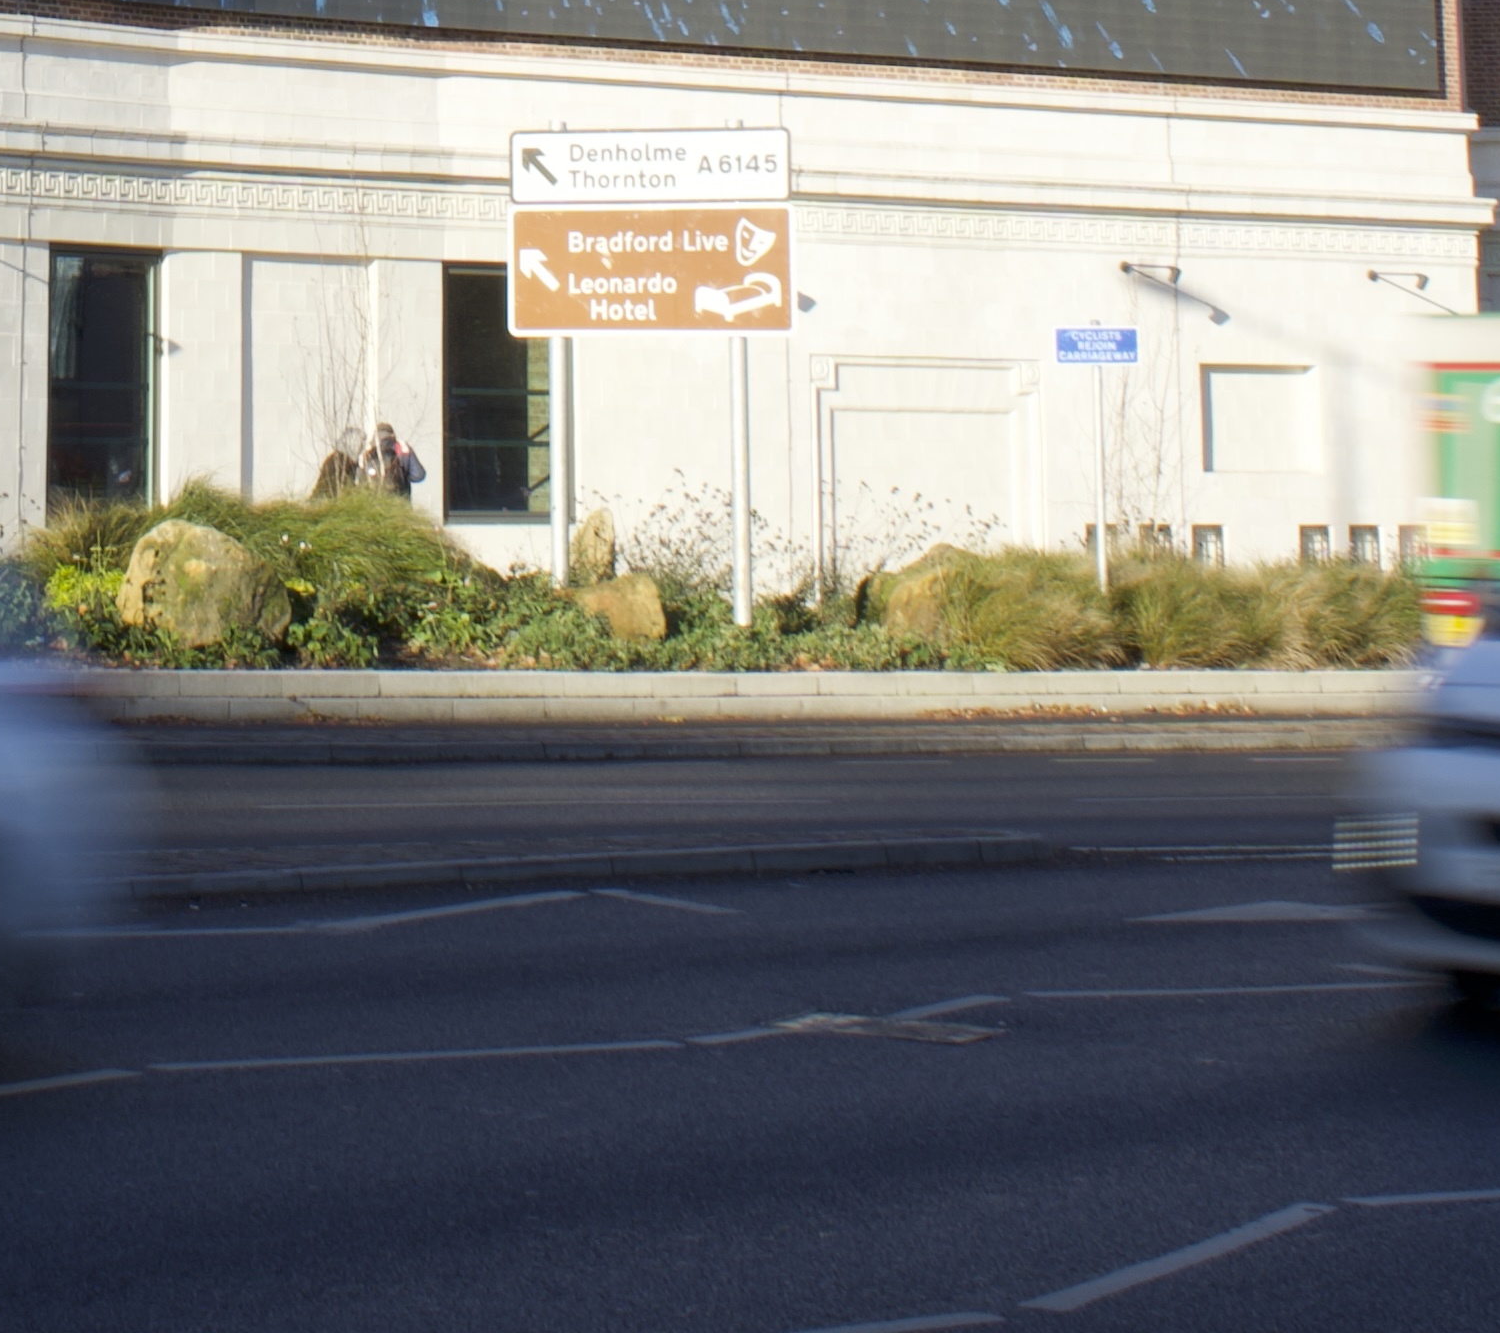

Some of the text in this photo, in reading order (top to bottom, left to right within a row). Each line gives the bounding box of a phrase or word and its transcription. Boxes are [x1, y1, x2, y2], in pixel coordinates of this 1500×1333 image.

[569, 143, 687, 162] Denholme
[568, 169, 677, 189] Thornton
[567, 230, 729, 253] Bradford Live
[567, 272, 678, 295] Leonardo
[589, 298, 657, 321] Hotel
[1070, 331, 1122, 341] CYCLISTS
[1077, 341, 1117, 351] REJOIN
[1059, 351, 1135, 361] CARRIAGEWAY
